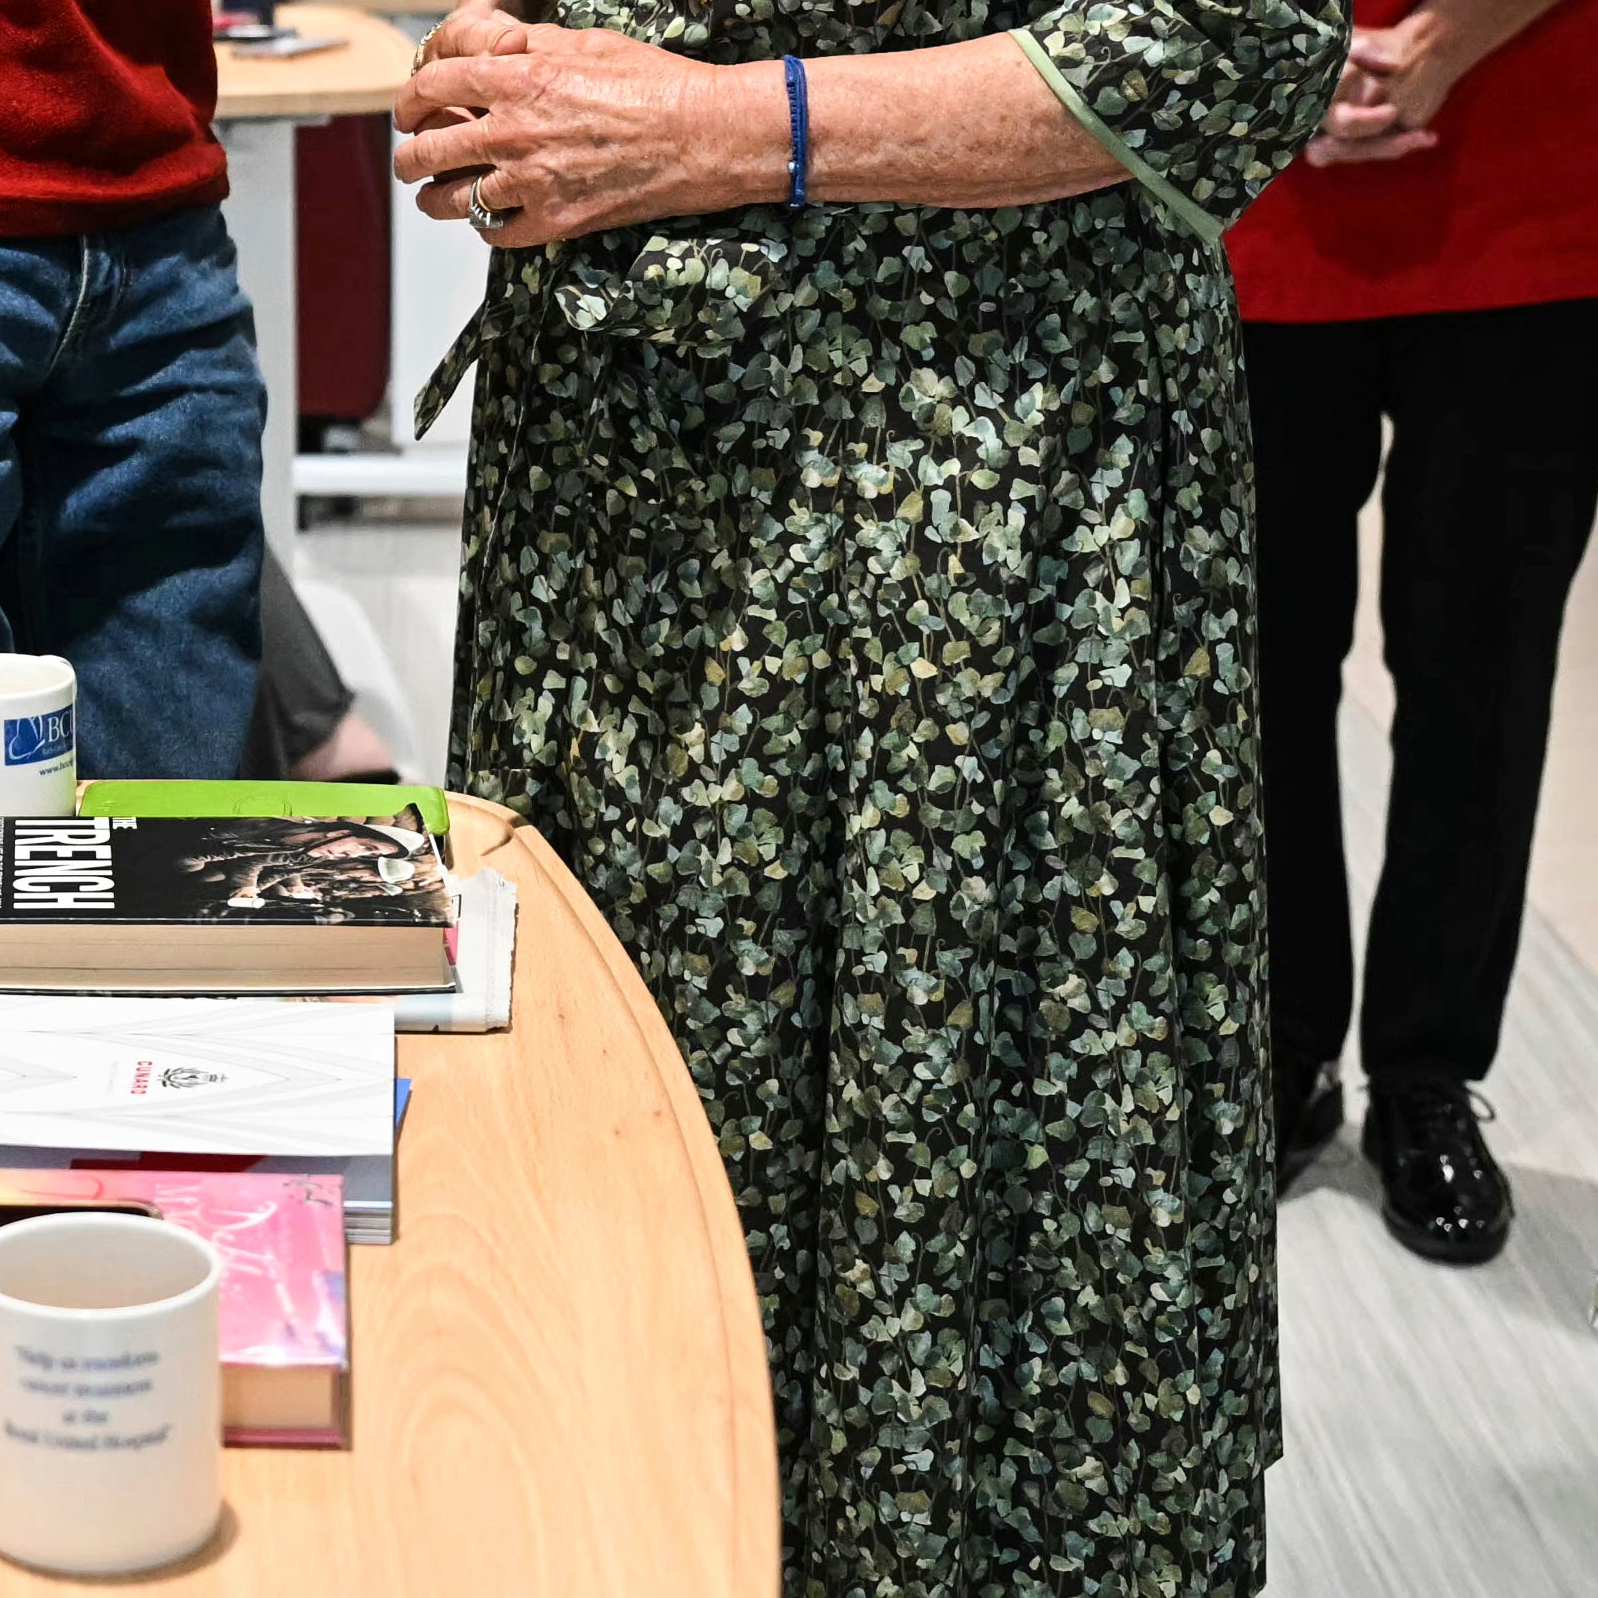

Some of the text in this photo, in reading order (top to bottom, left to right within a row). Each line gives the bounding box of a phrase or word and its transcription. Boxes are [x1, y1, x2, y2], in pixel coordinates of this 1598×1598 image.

[112, 817, 137, 830] THE
[12, 817, 115, 909] TRENCH
[130, 1061, 152, 1094] CUNARD
